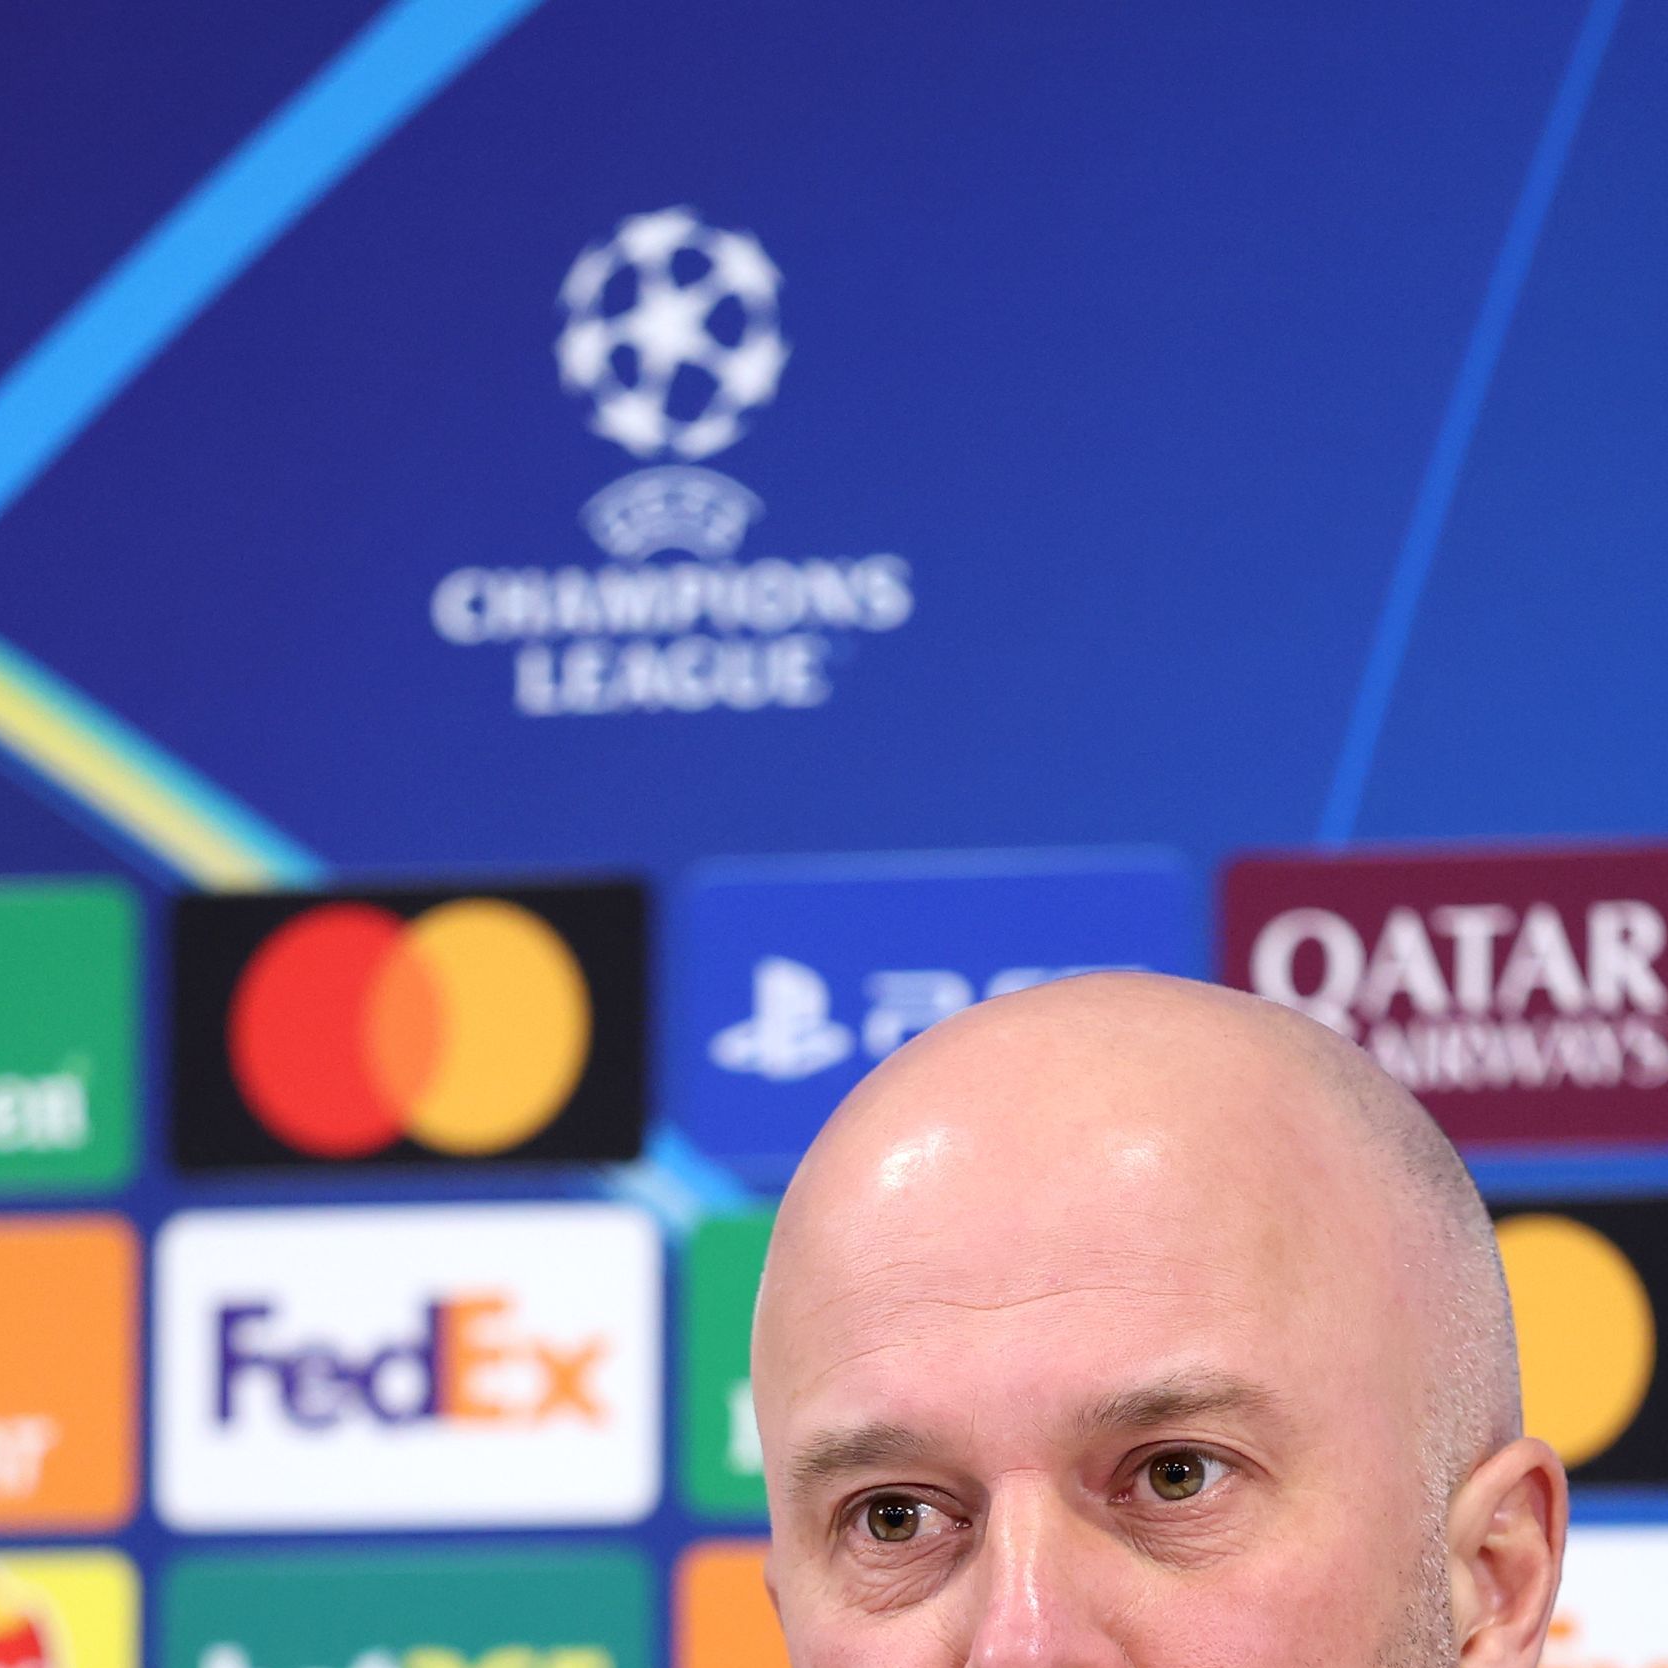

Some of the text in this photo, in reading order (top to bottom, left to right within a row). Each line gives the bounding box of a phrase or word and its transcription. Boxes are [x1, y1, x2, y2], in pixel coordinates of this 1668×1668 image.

[432, 554, 912, 645] CHAMPIONS
[514, 634, 830, 716] LEAGUE
[214, 1293, 614, 1427] FedEx
